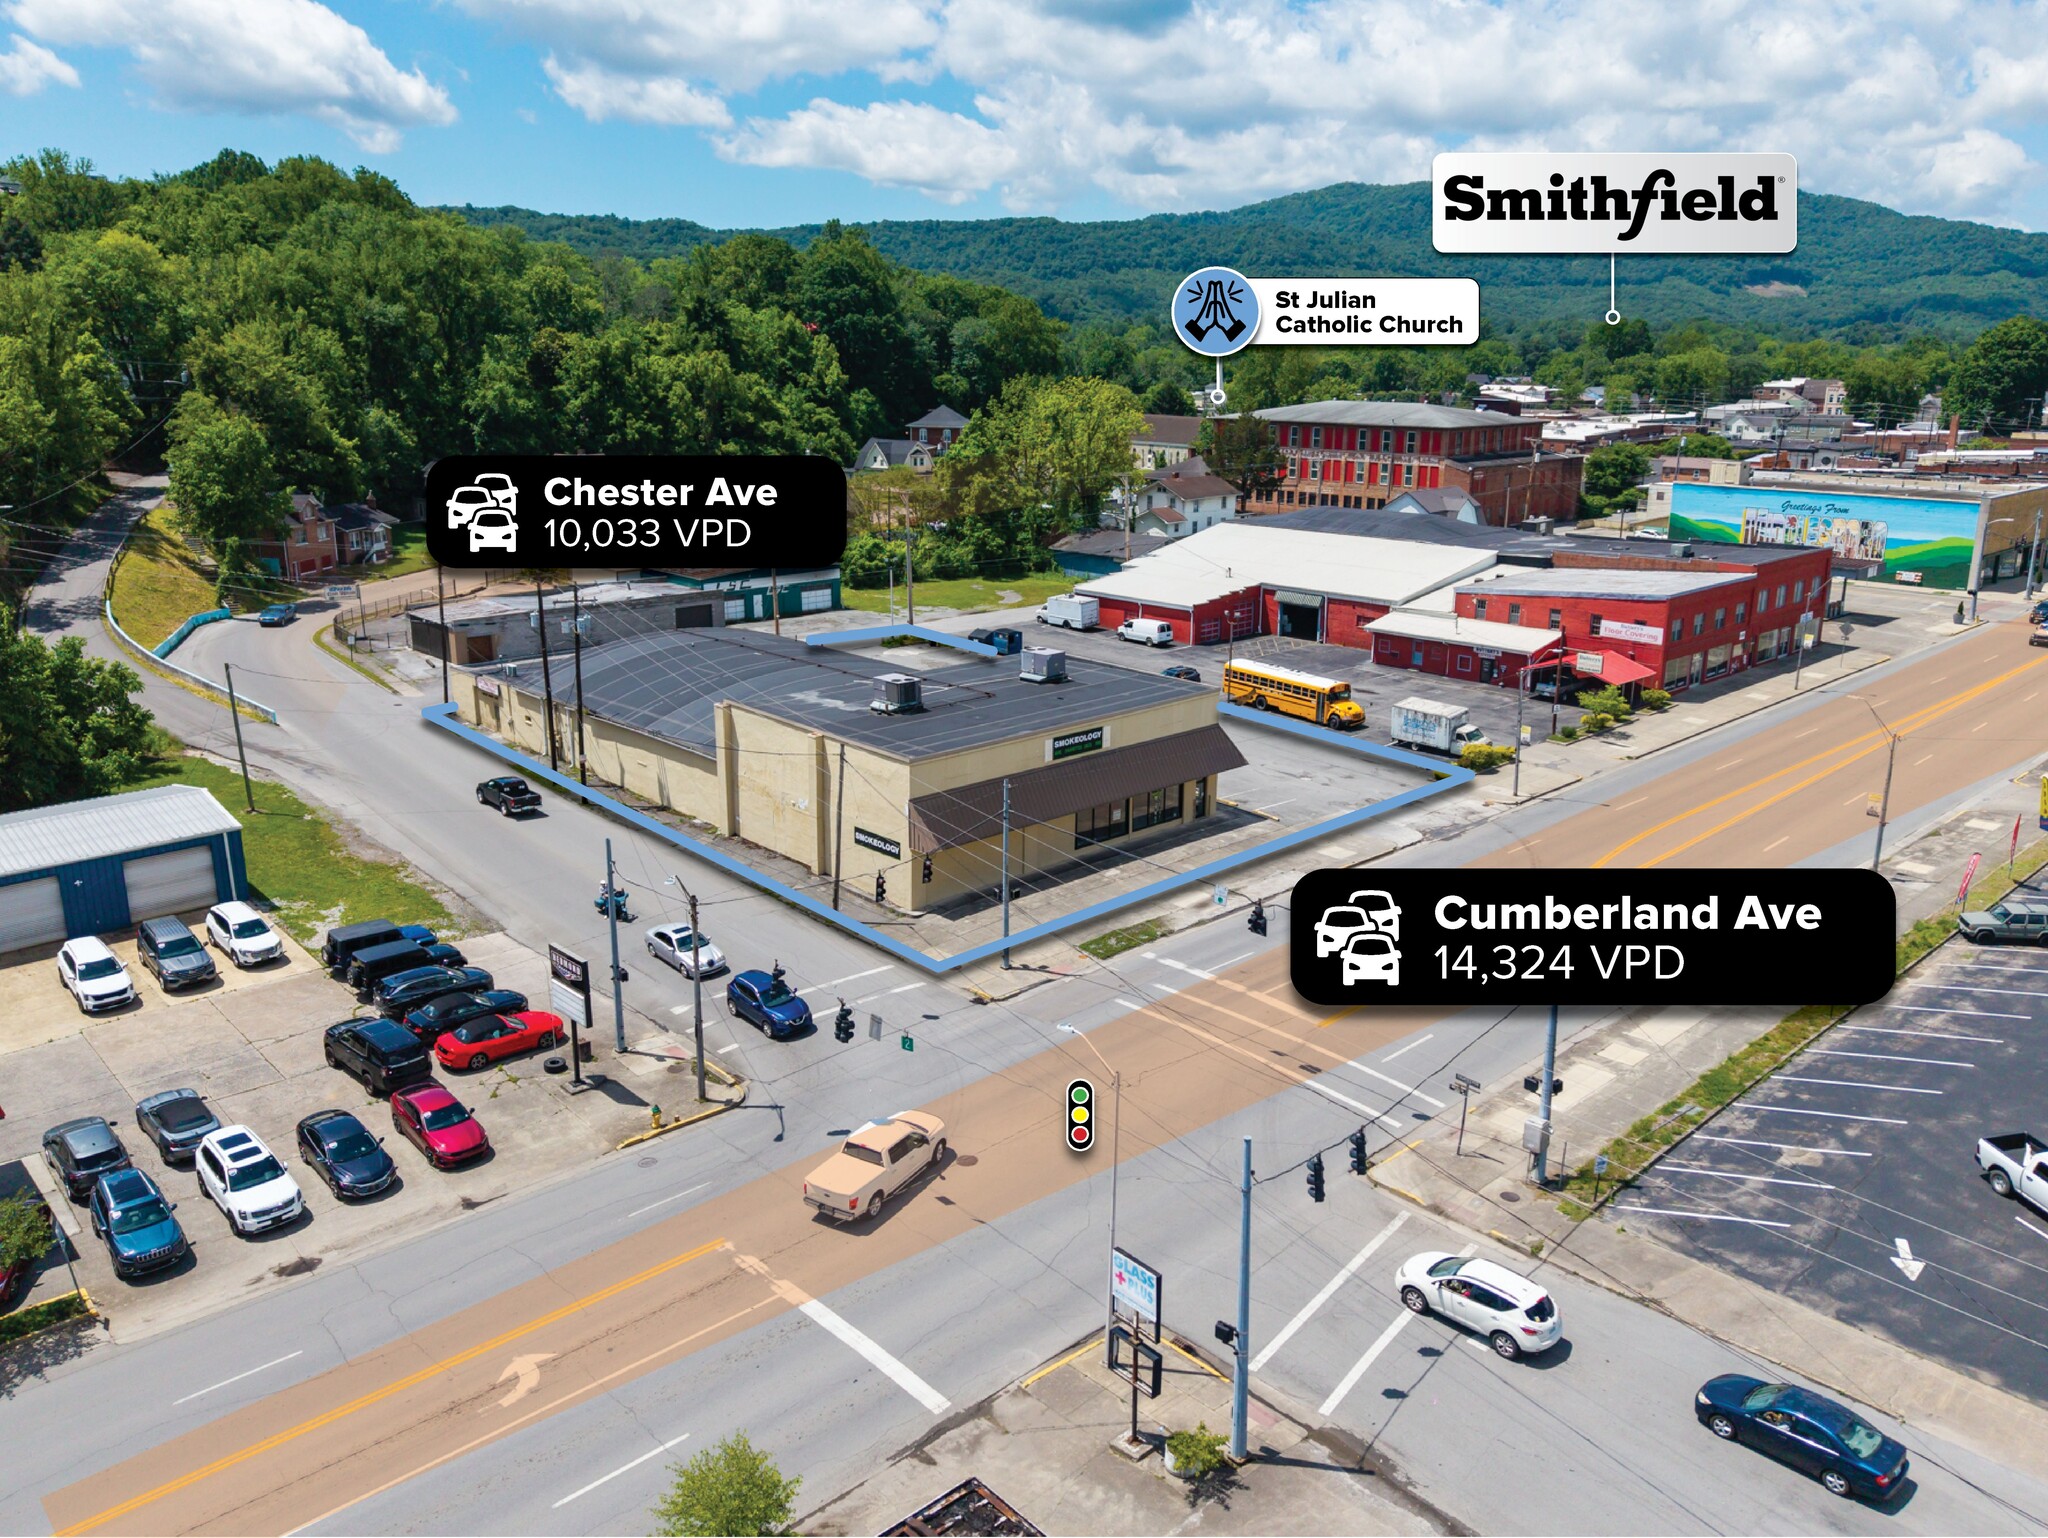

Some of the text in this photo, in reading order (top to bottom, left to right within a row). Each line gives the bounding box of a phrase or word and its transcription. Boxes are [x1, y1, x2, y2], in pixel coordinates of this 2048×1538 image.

[1781, 500, 1850, 514] Greetings From
[1604, 626, 1623, 635] Floor
[1625, 629, 1659, 641] Covering
[1054, 731, 1102, 748] SMOKEOLOGY
[855, 831, 900, 854] SMOKEOLOGY
[904, 1038, 911, 1050] 2
[1113, 1254, 1155, 1290] GLASS
[1128, 1277, 1153, 1305] PLUS
